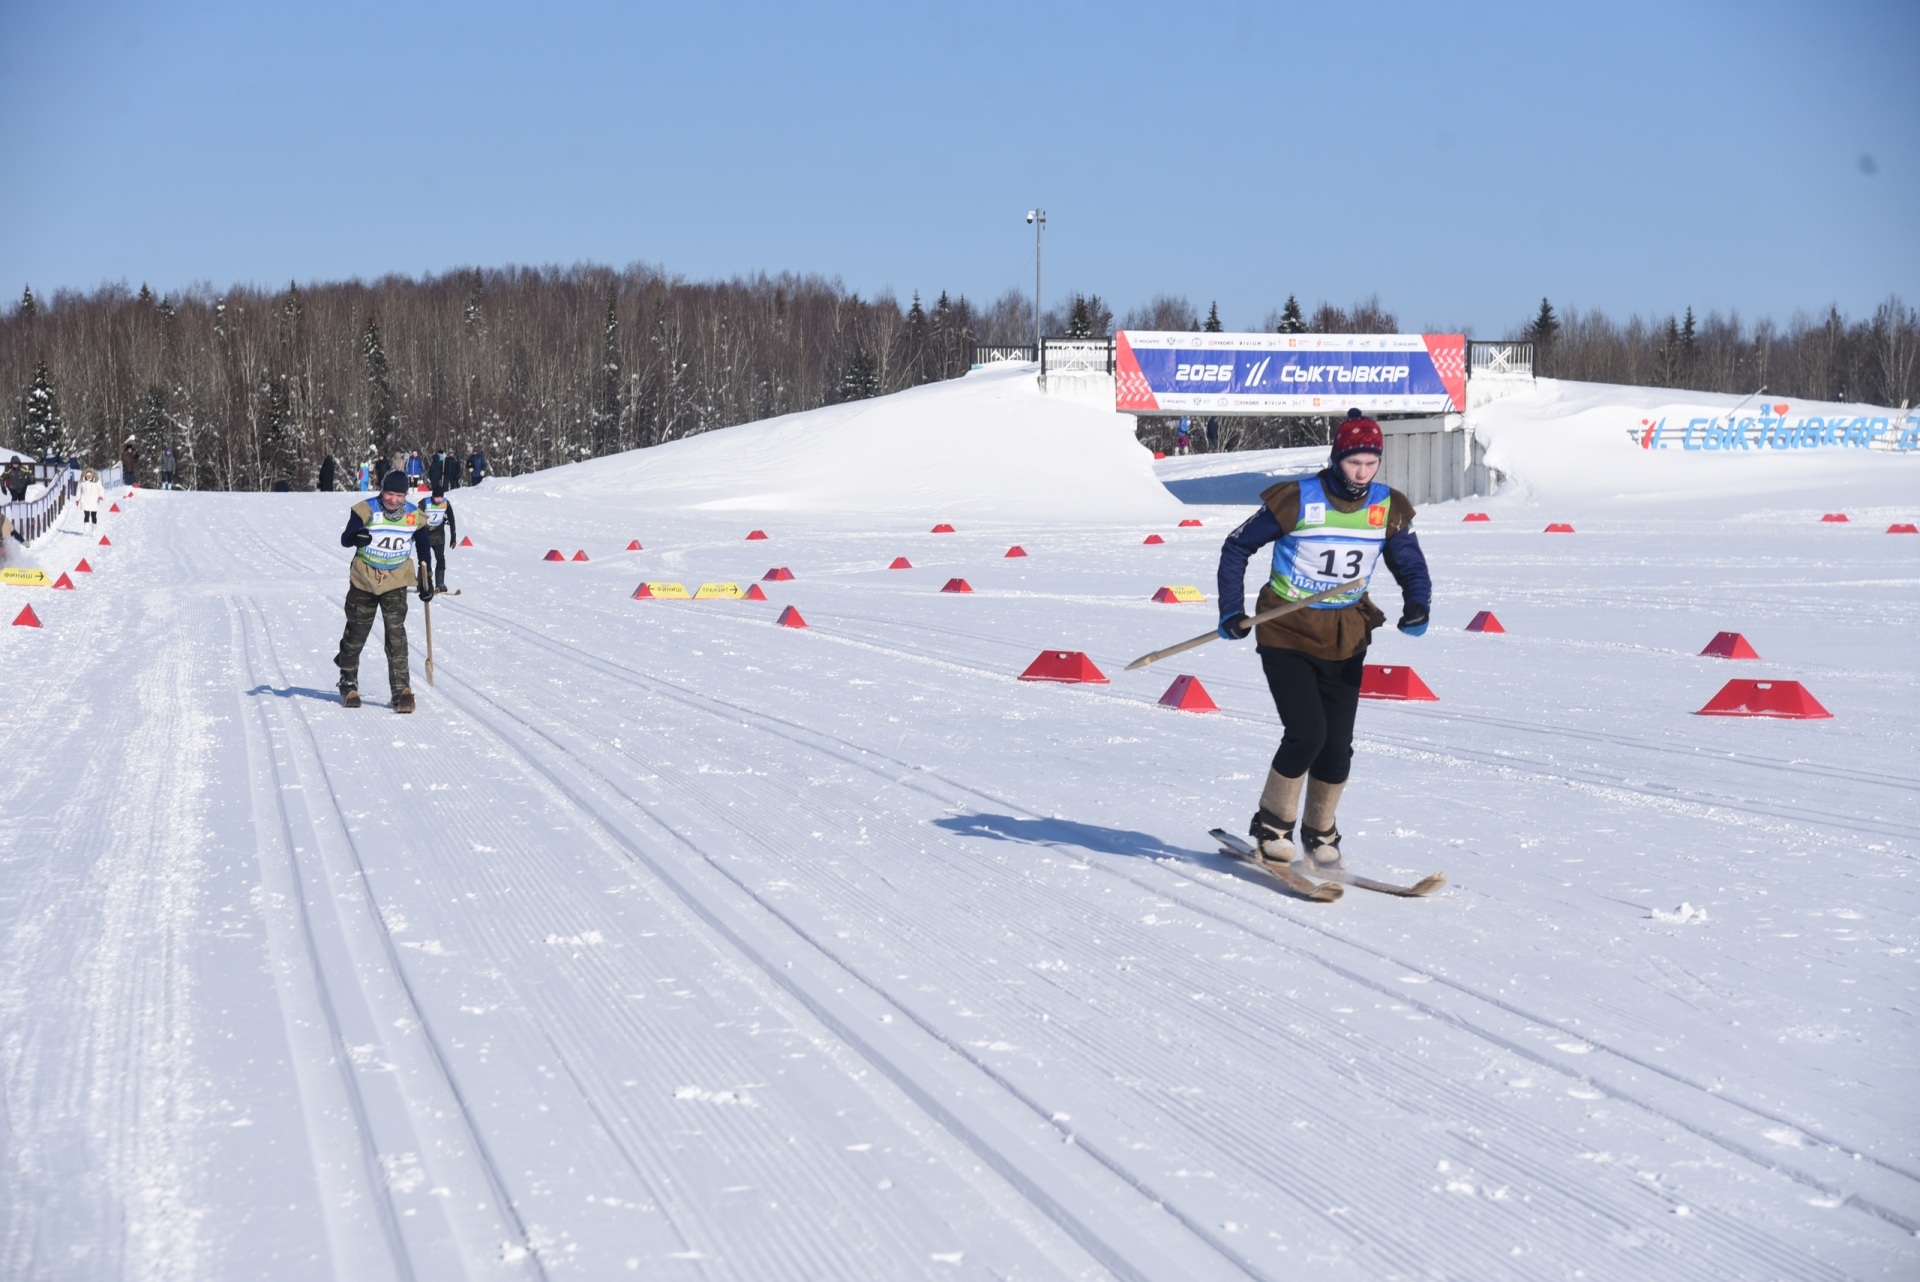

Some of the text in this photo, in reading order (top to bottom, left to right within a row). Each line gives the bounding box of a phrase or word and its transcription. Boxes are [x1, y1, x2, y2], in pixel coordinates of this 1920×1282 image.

[1175, 363, 1410, 383] 2026 СЫКТЫВКАР
[1760, 403, 1771, 416] Я
[1683, 416, 1889, 450] СЫКТЫВКАР
[1316, 549, 1364, 579] 13
